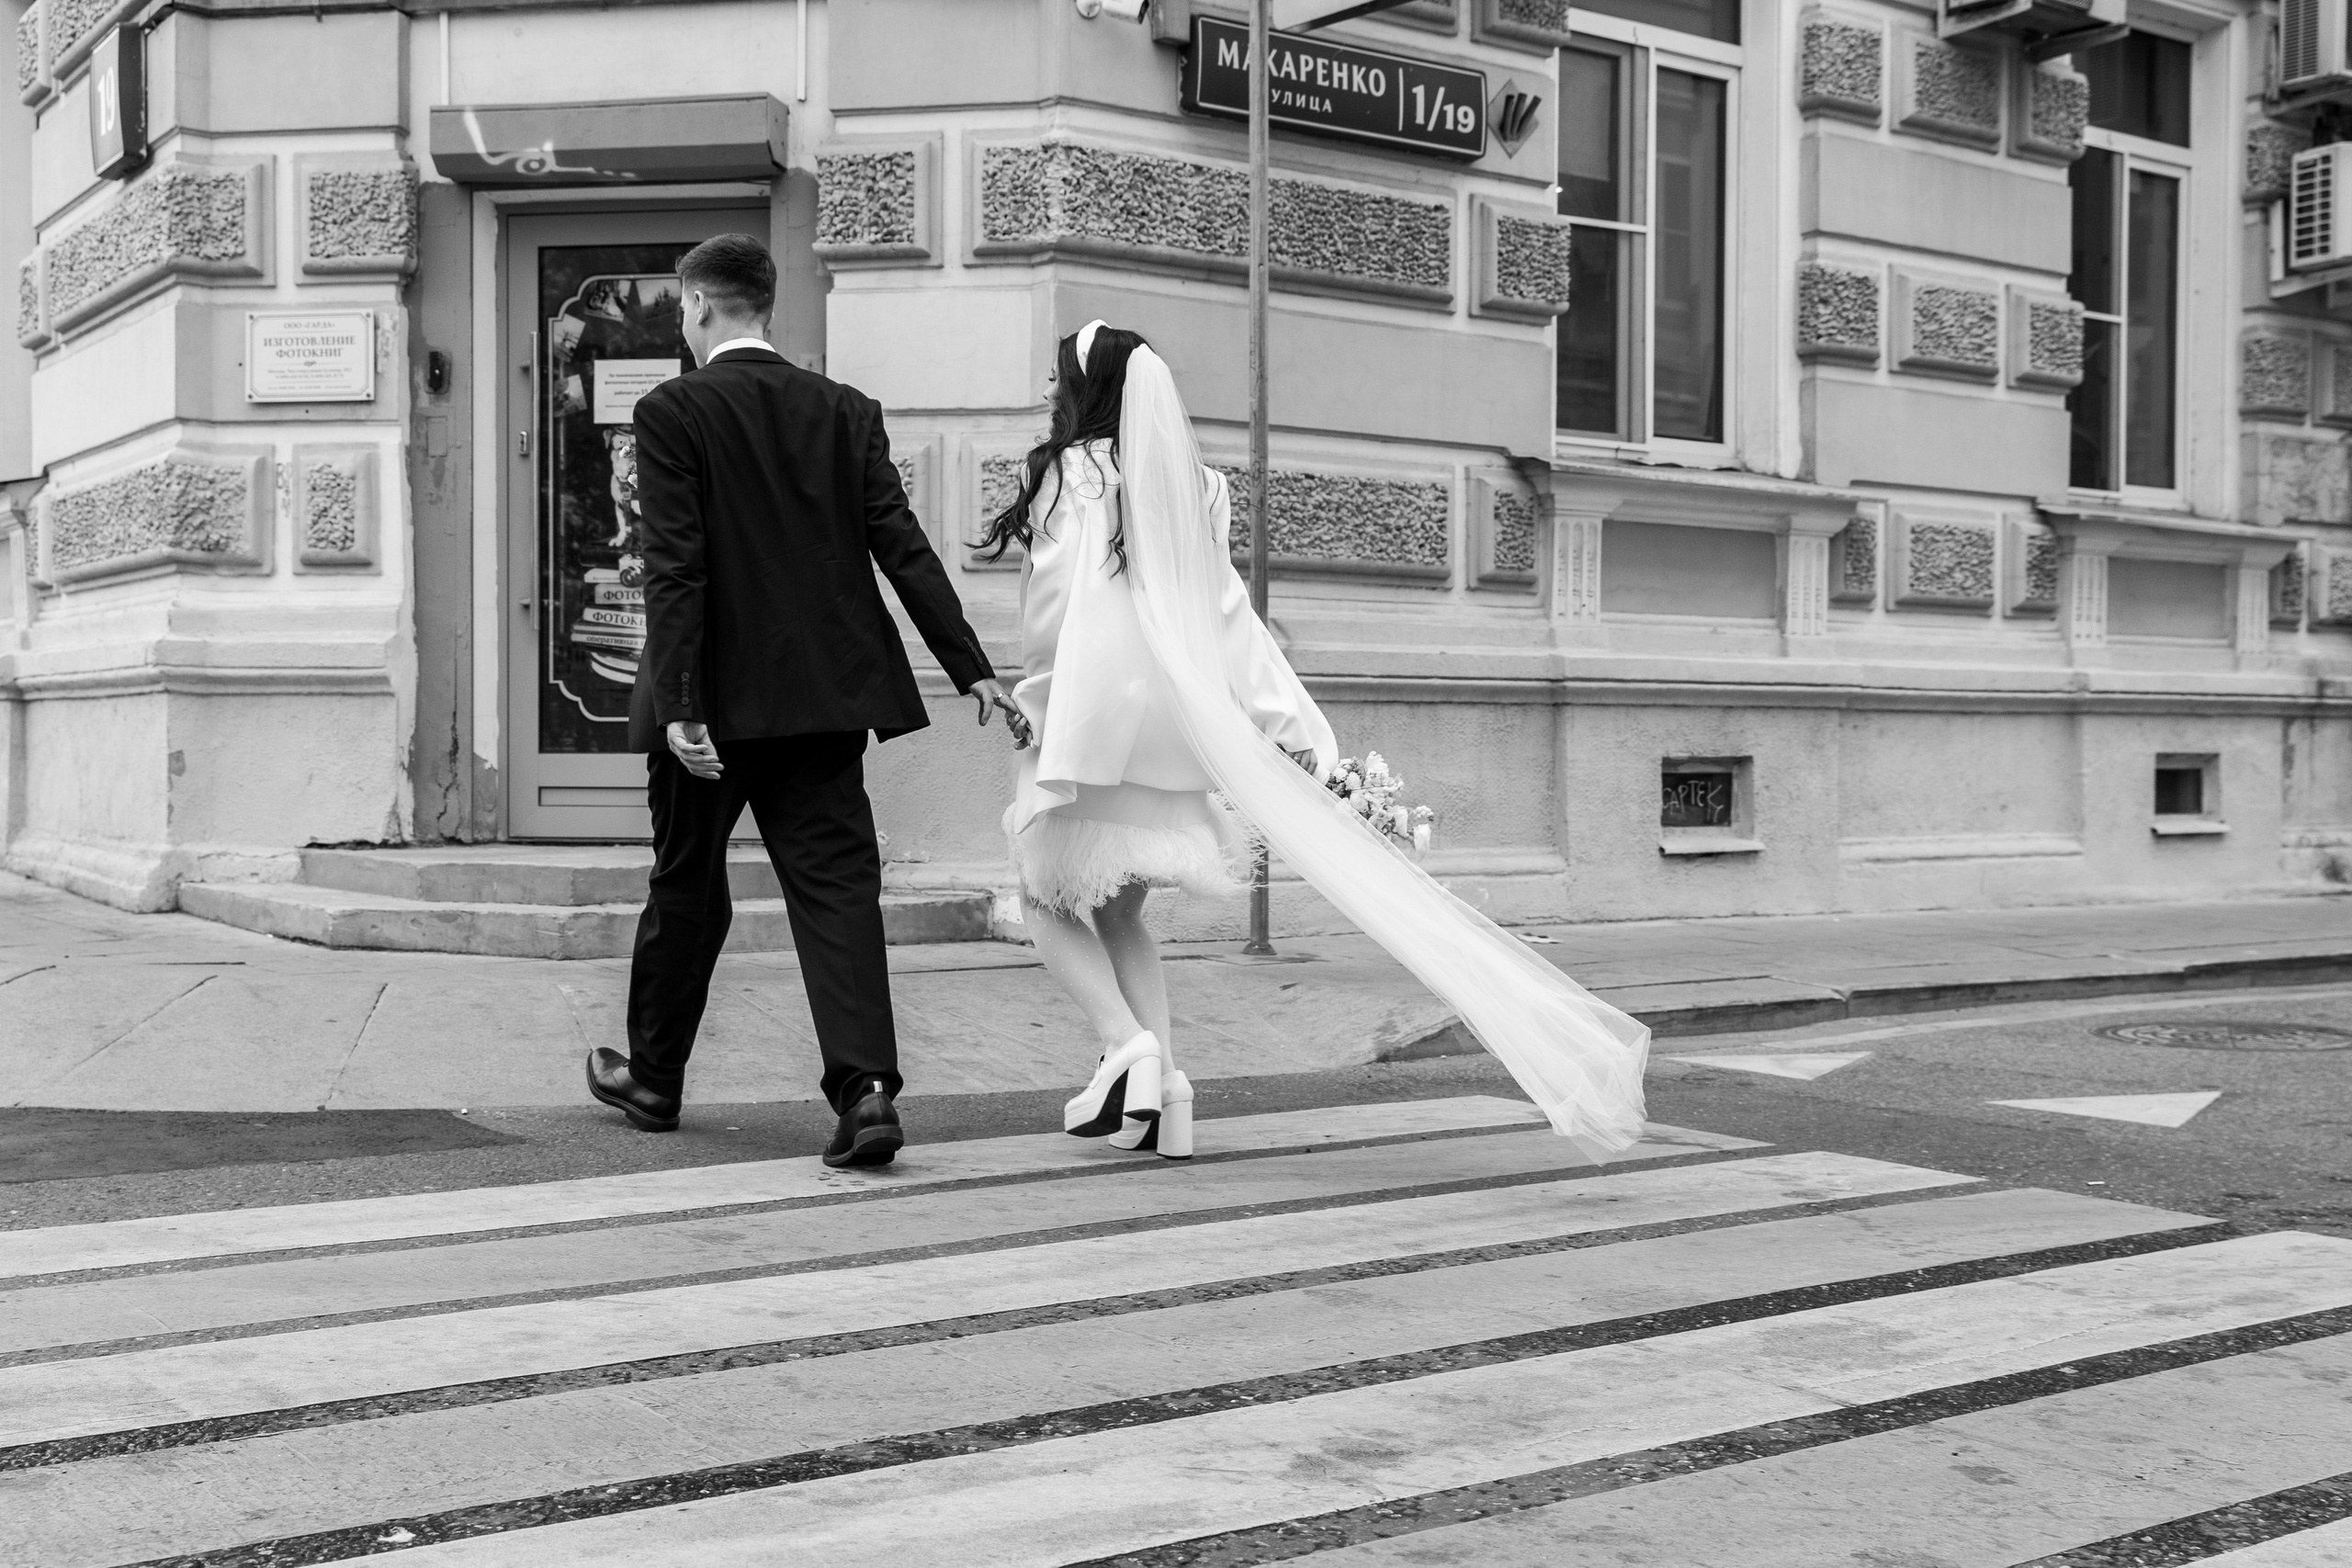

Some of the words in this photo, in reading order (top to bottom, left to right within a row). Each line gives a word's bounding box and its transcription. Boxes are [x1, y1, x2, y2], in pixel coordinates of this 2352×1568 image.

[97, 66, 116, 137] 19
[1271, 88, 1332, 114] УЛИЦА
[1411, 84, 1476, 133] 1/19
[264, 335, 356, 347] ИЗГОТОВЛЕНИЕ
[276, 347, 344, 358] ФОТОКНИГ
[604, 590, 644, 601] ФОТО
